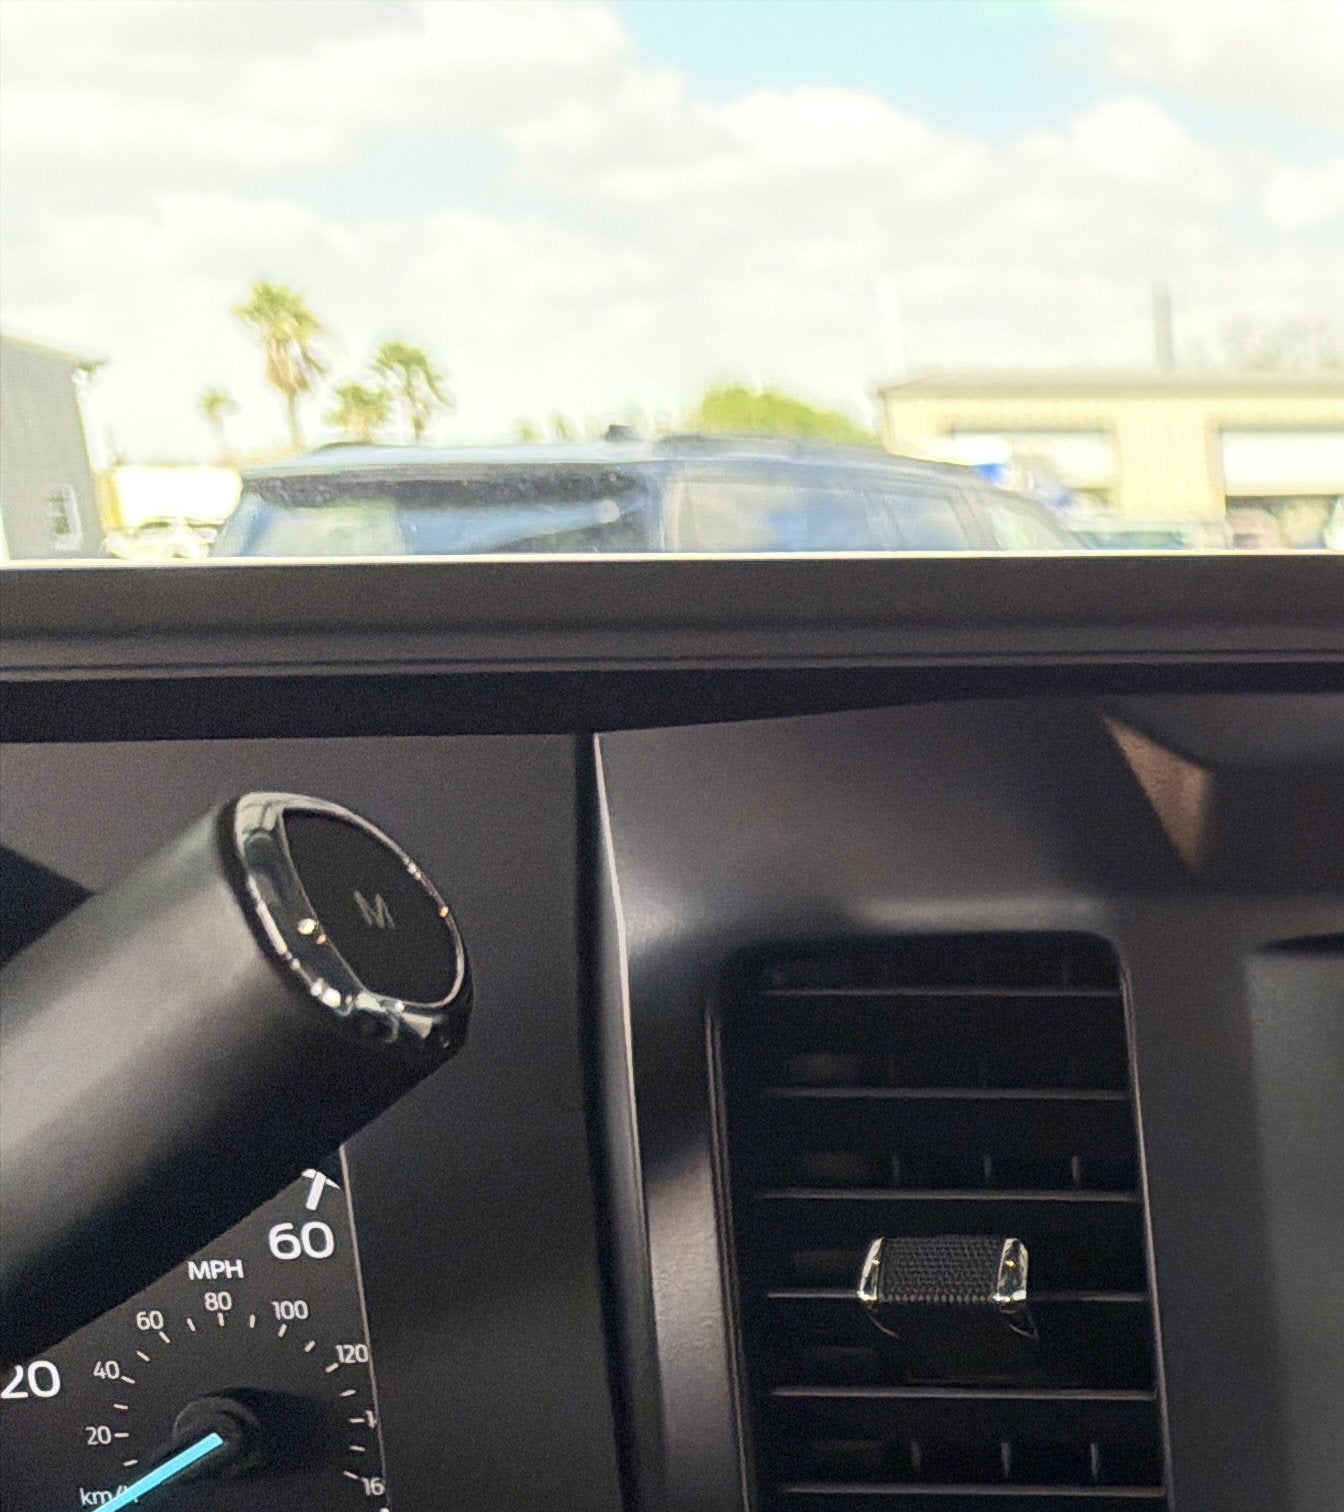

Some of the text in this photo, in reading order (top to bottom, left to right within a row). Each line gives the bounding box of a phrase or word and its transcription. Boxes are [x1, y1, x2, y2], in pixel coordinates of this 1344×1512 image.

[353, 890, 396, 930] M
[268, 1221, 334, 1259] 60
[187, 1259, 245, 1281] MPH
[136, 1300, 309, 1330] 60 100
[203, 1292, 232, 1311] 80
[92, 1343, 370, 1380] 40 120
[85, 1426, 112, 1446] 20
